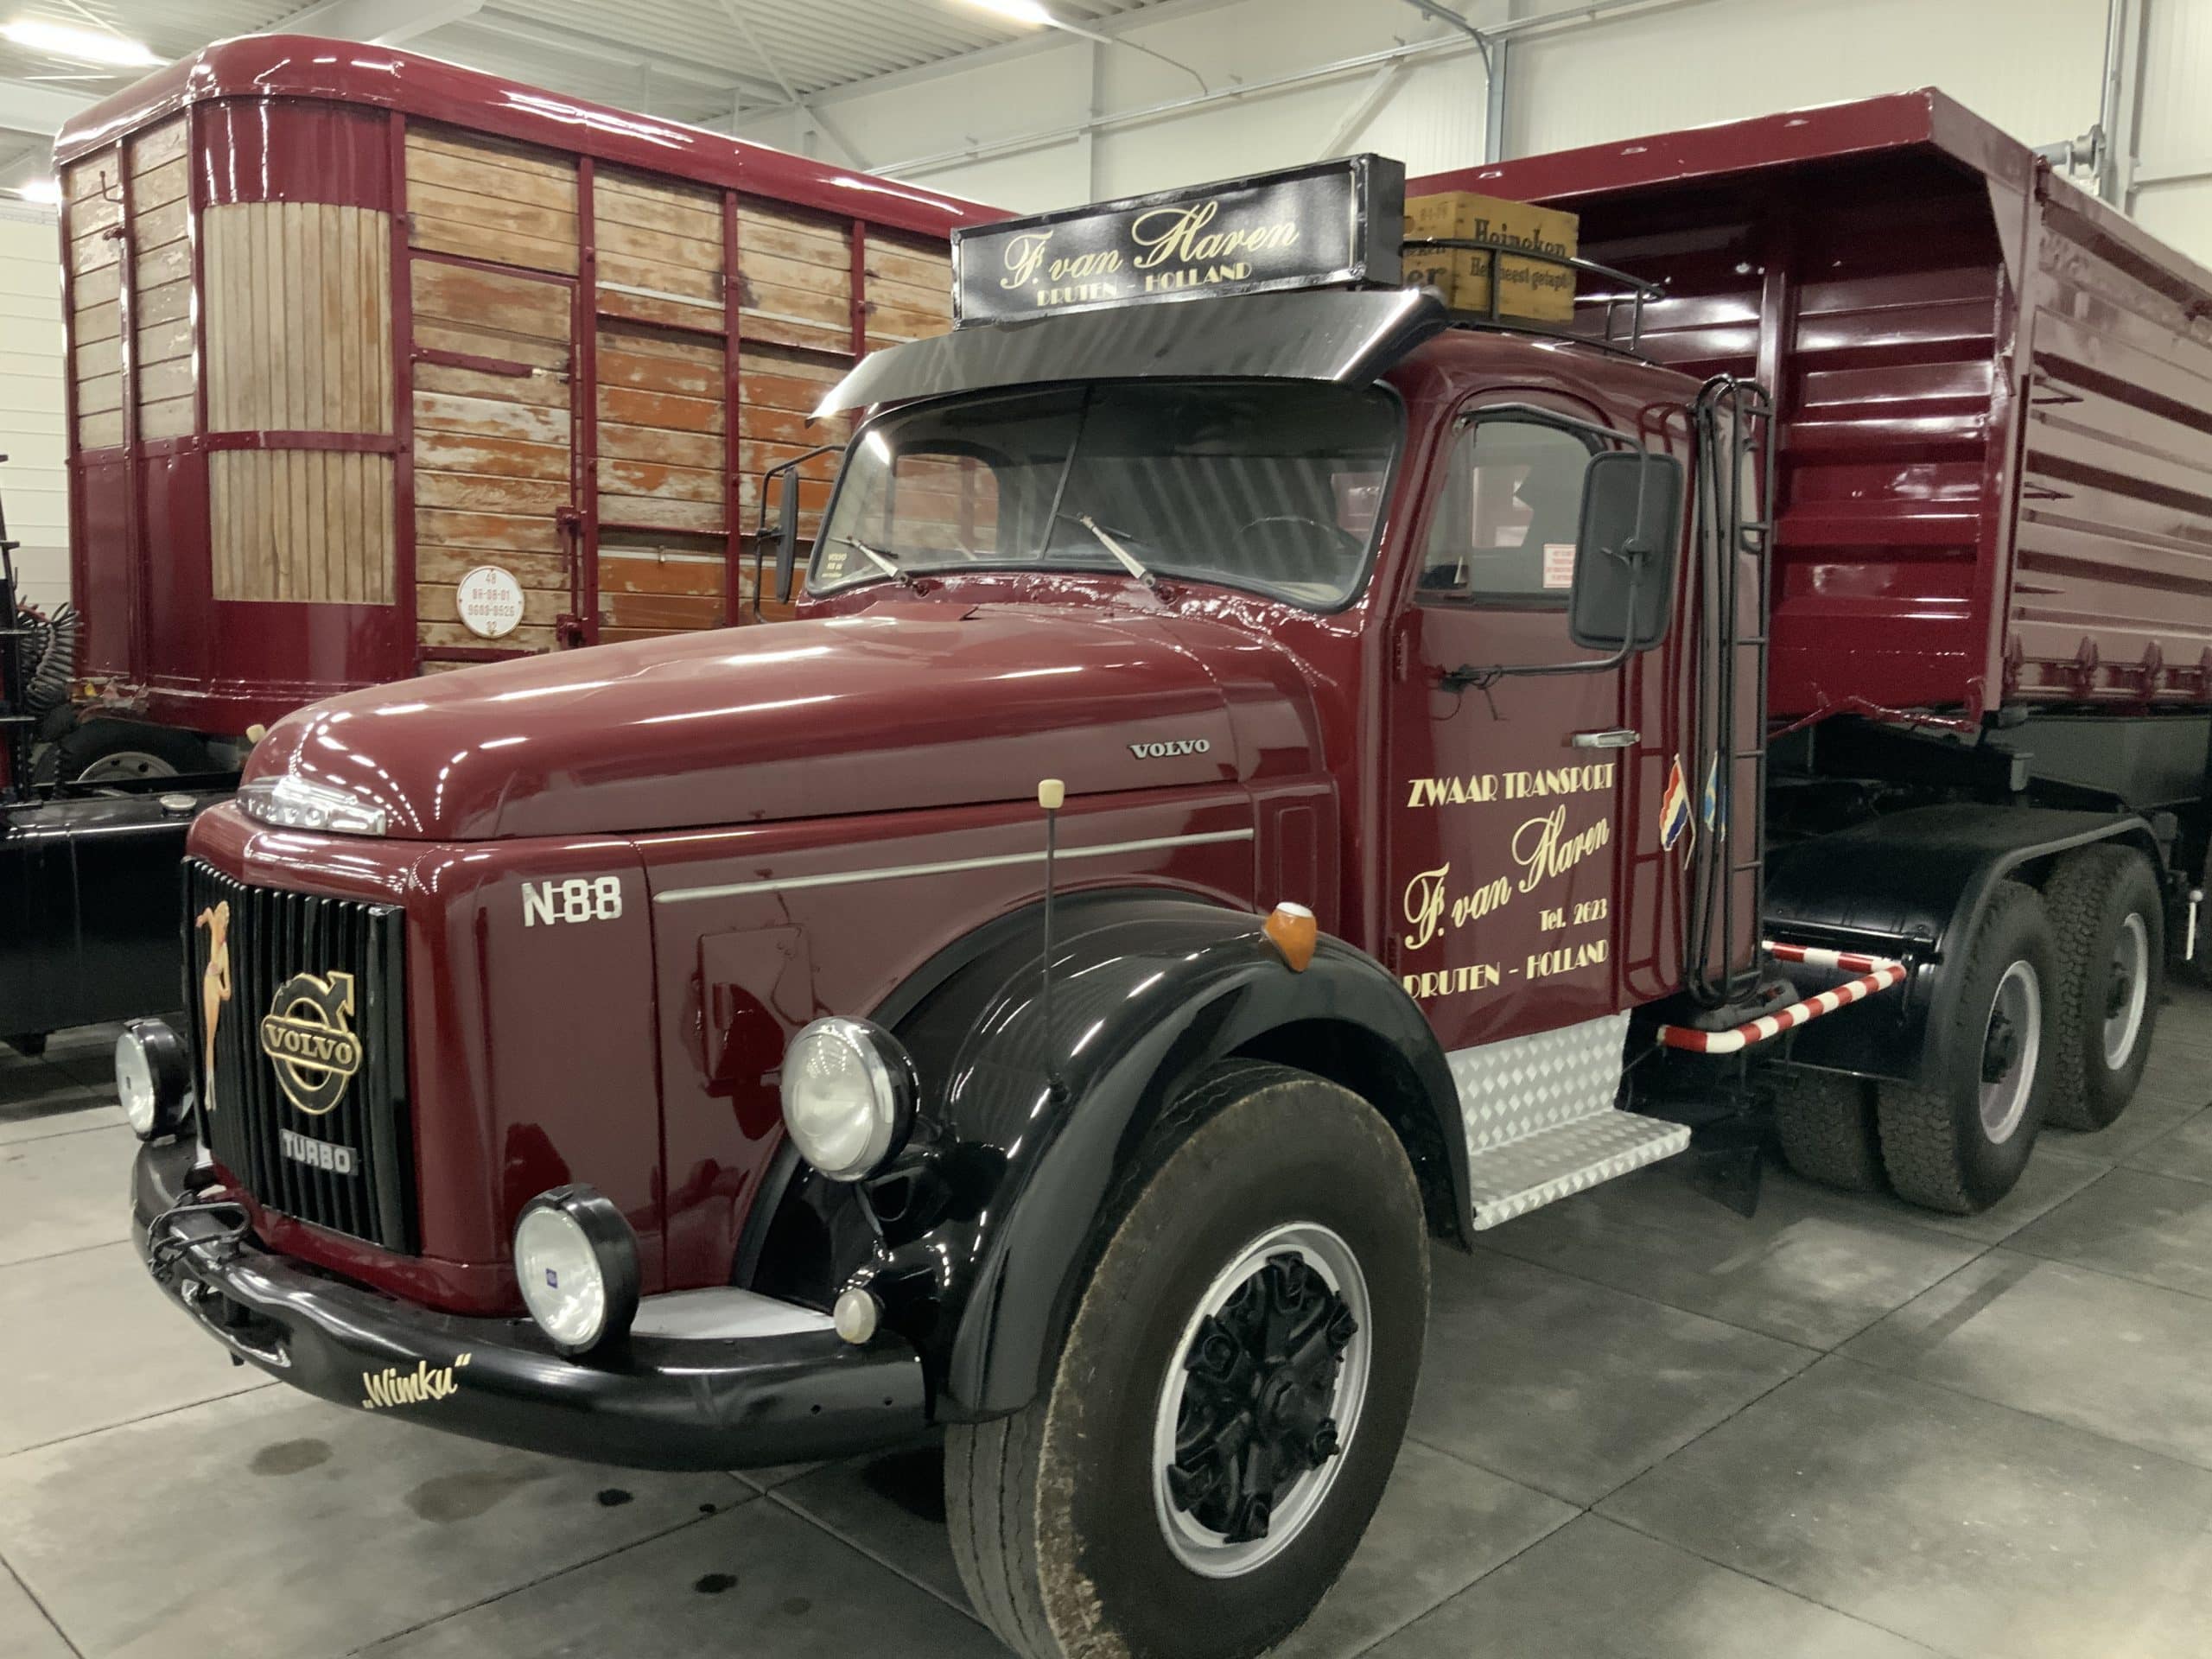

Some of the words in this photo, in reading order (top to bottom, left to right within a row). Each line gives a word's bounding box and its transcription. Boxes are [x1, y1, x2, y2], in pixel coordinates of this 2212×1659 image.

[1000, 230, 1054, 289] F.
[1048, 250, 1123, 281] van
[1132, 200, 1300, 269] Haren
[1038, 279, 1118, 307] DRUTEN
[1146, 262, 1253, 292] HOLLAND
[1127, 739, 1211, 760] VOLVO
[1407, 775, 1498, 808] ZWAAR
[1503, 763, 1615, 799] TRANSPORT
[1404, 862, 1450, 950] F.
[1451, 875, 1512, 928] van
[1512, 804, 1610, 893] Haren
[1539, 907, 1567, 931] Tel.
[1573, 898, 1607, 925] 2623
[1403, 961, 1501, 999] DRUTEN
[1526, 939, 1609, 980] HOLLAND
[265, 1024, 353, 1065] VOLVO
[283, 1132, 351, 1173] TURBO
